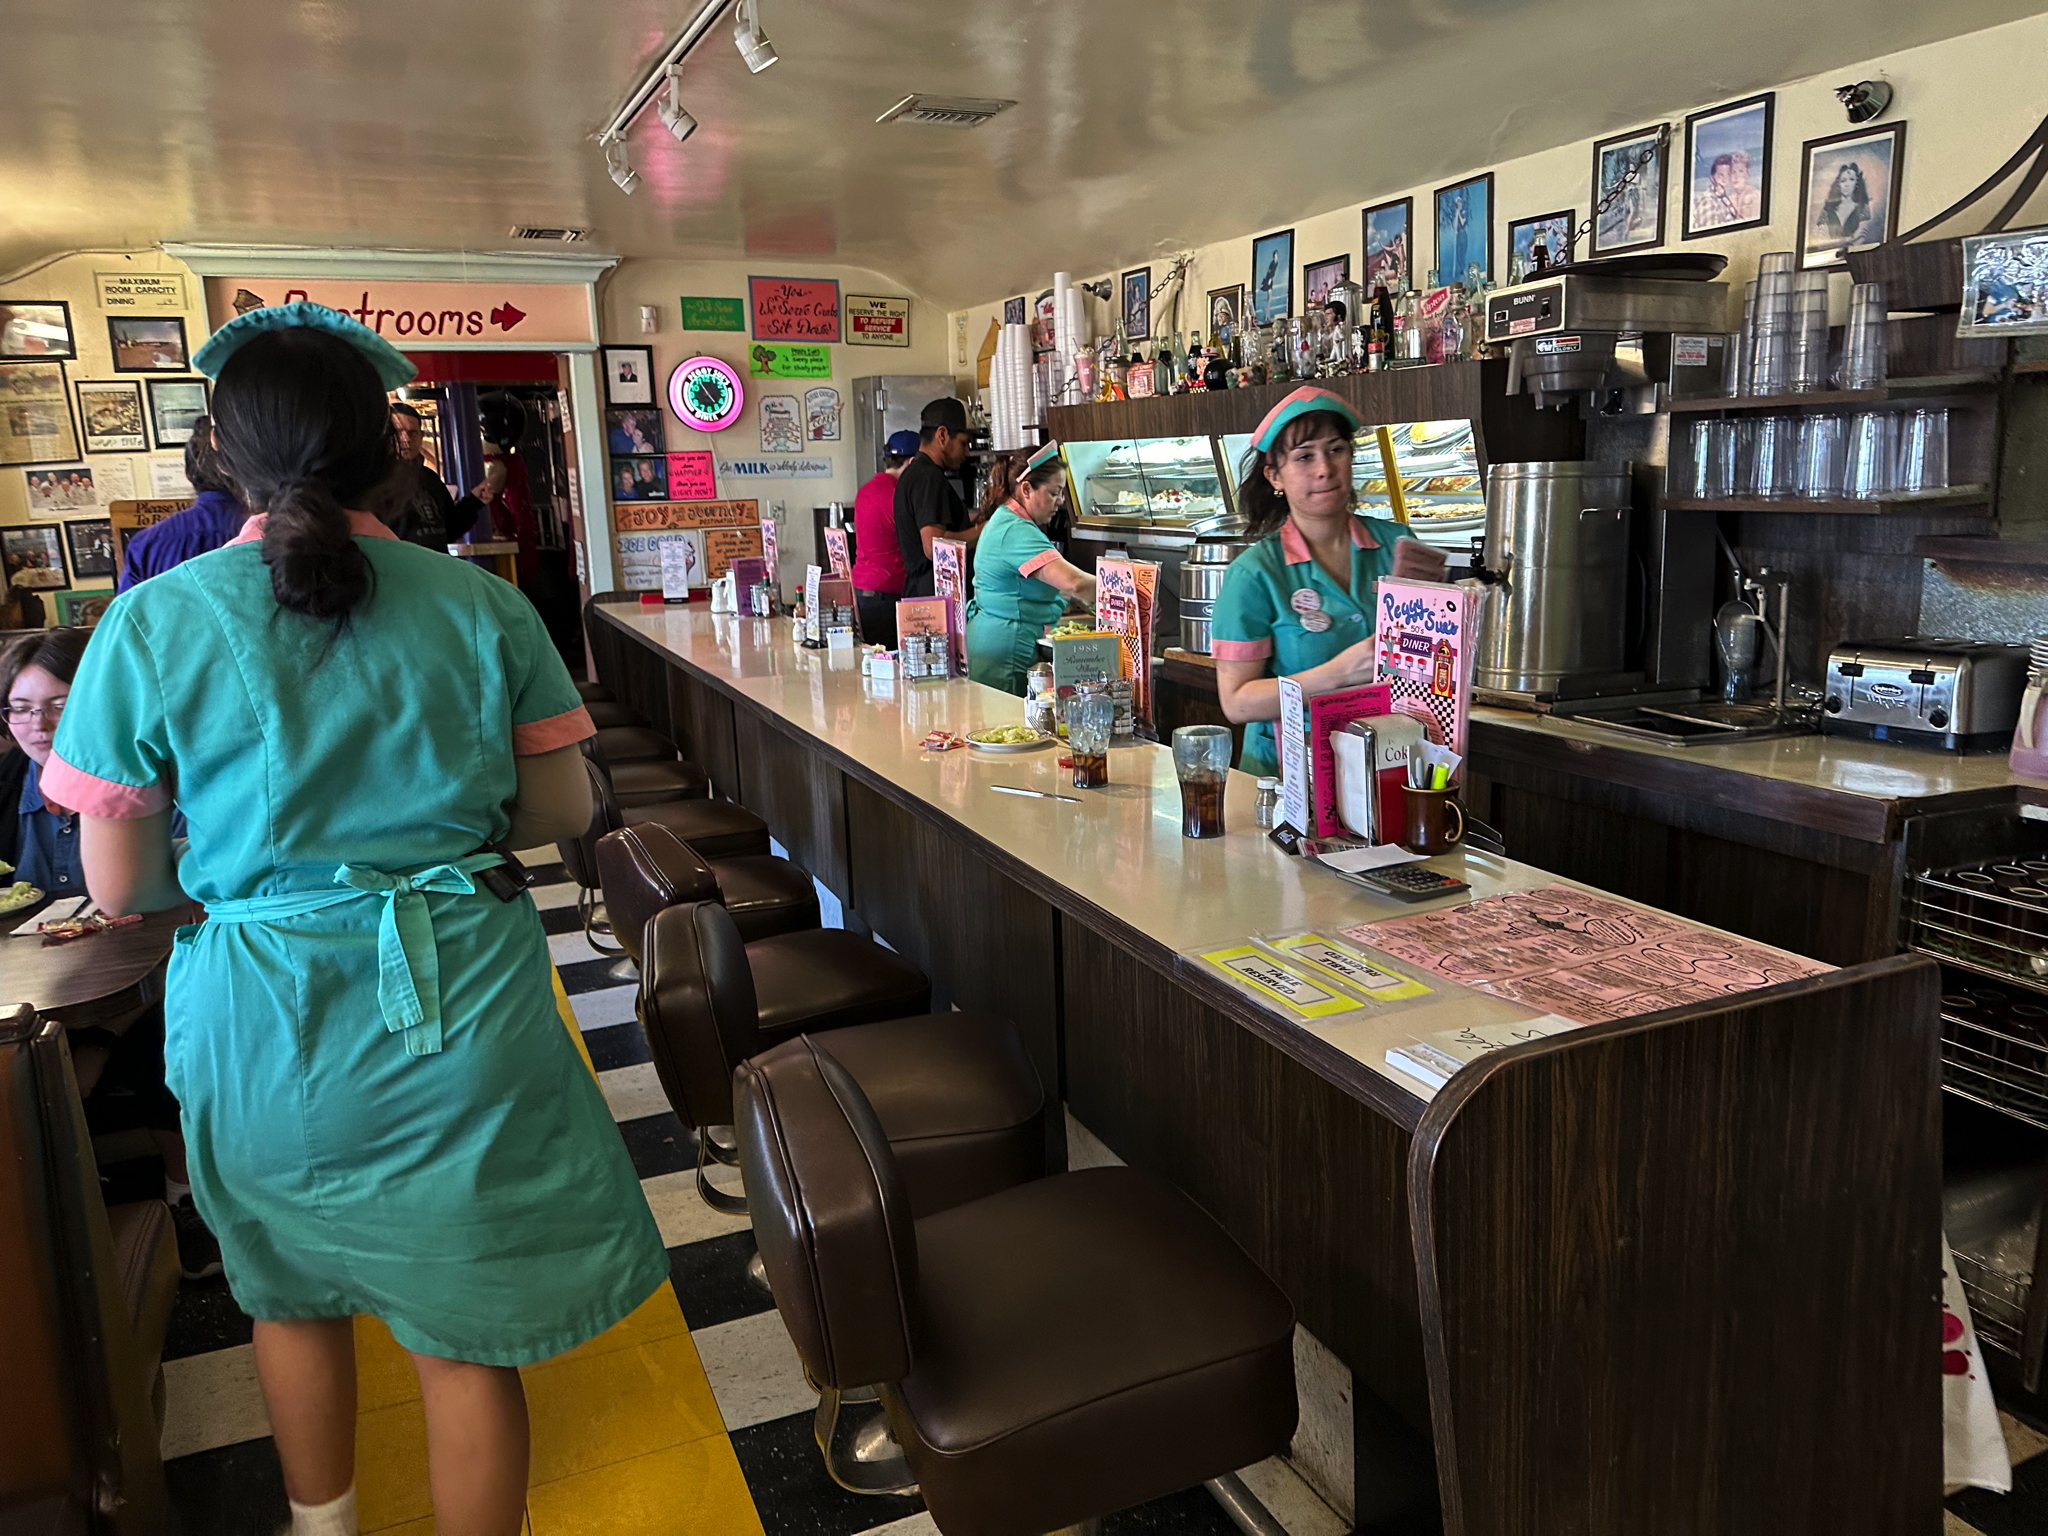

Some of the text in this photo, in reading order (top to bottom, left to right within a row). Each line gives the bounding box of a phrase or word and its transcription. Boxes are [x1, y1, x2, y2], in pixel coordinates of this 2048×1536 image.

[135, 286, 177, 294] CAPACITY
[869, 301, 887, 309] WE
[1422, 293, 1445, 314] Lipton
[1513, 295, 1535, 305] BUNN
[284, 290, 484, 336] trooms
[849, 308, 875, 316] RESERVE
[870, 318, 896, 326] REFUSE
[687, 367, 712, 381] PEGGY
[694, 411, 719, 421] DINER
[674, 468, 702, 477] HAPPIER
[734, 462, 770, 475] MILK
[672, 489, 692, 497] RIGHT
[135, 501, 173, 513] Please
[135, 514, 149, 526] To
[632, 505, 669, 526] JOY
[1099, 567, 1121, 590] Peggy
[1110, 598, 1125, 608] DINER
[1383, 593, 1459, 636] Peggy Sue's
[1410, 625, 1425, 635] 50's
[1073, 644, 1098, 653] 1988
[1402, 639, 1430, 653] DINER
[1063, 654, 1105, 664] Remember
[1385, 745, 1408, 762] Cok
[1319, 957, 1355, 976] TABLE
[1324, 950, 1382, 977] RESERVED
[1241, 967, 1297, 996] RESERVED
[1265, 968, 1303, 987] TABLE
